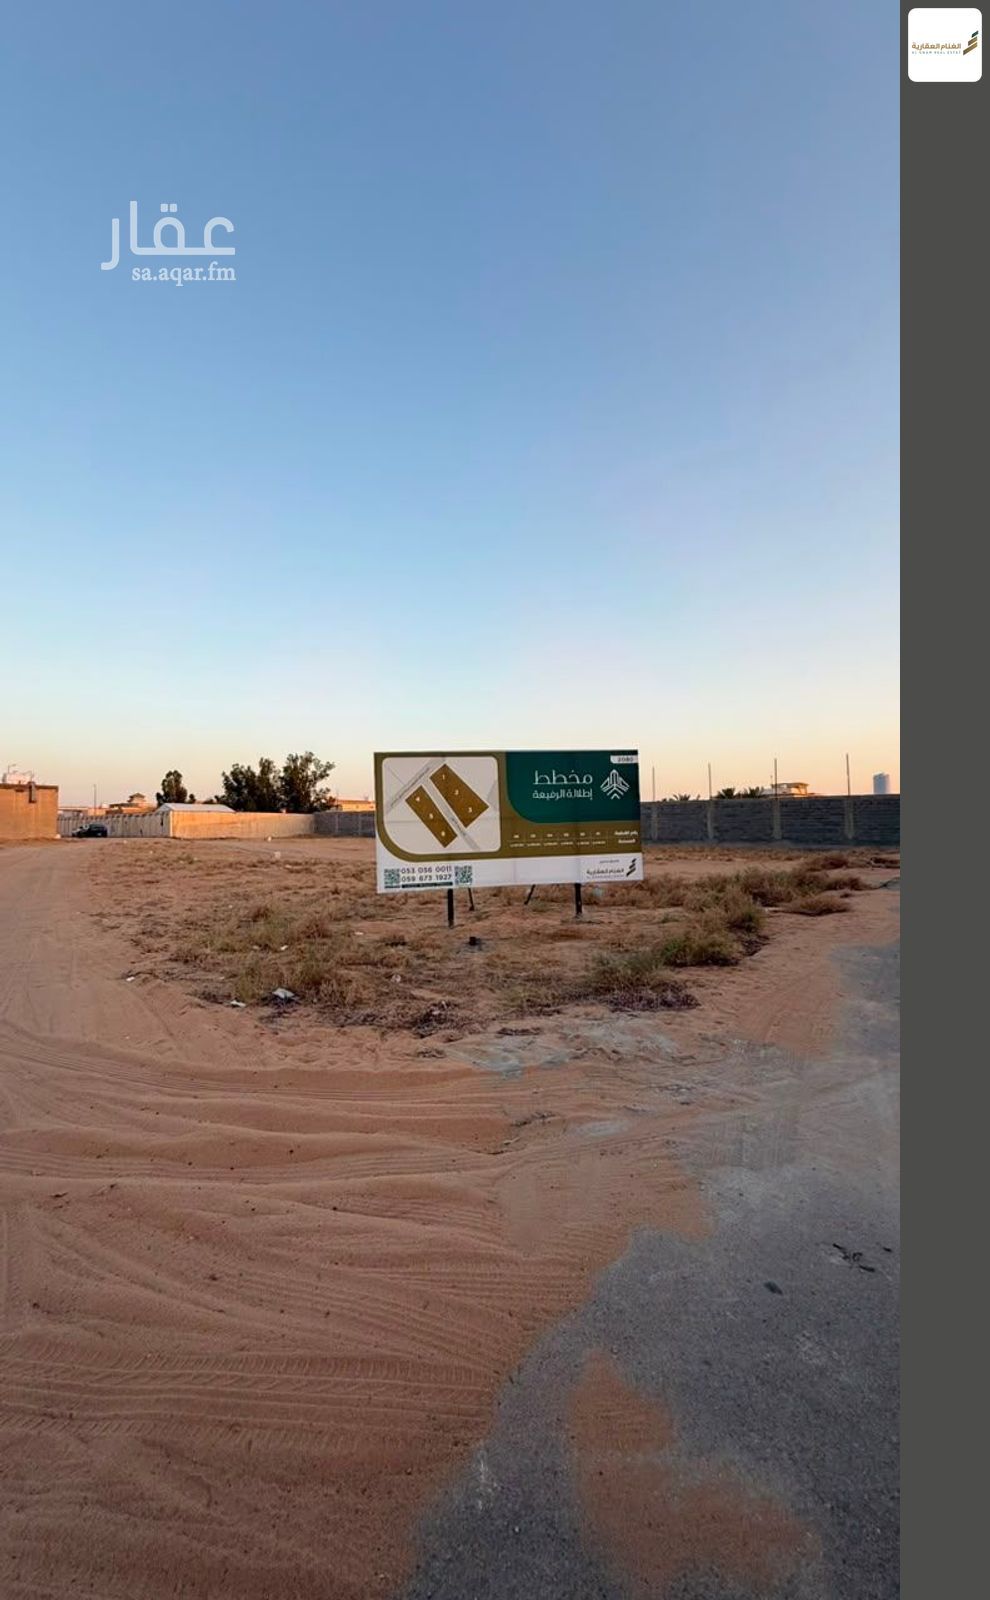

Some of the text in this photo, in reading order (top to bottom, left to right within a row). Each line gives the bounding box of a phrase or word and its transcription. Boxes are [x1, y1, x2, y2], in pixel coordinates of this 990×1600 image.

[532, 769, 593, 785] مخطط
[532, 788, 565, 801] الرفيعة
[418, 866, 432, 874] 056
[435, 865, 452, 873] 0011
[436, 873, 452, 881] 1927
